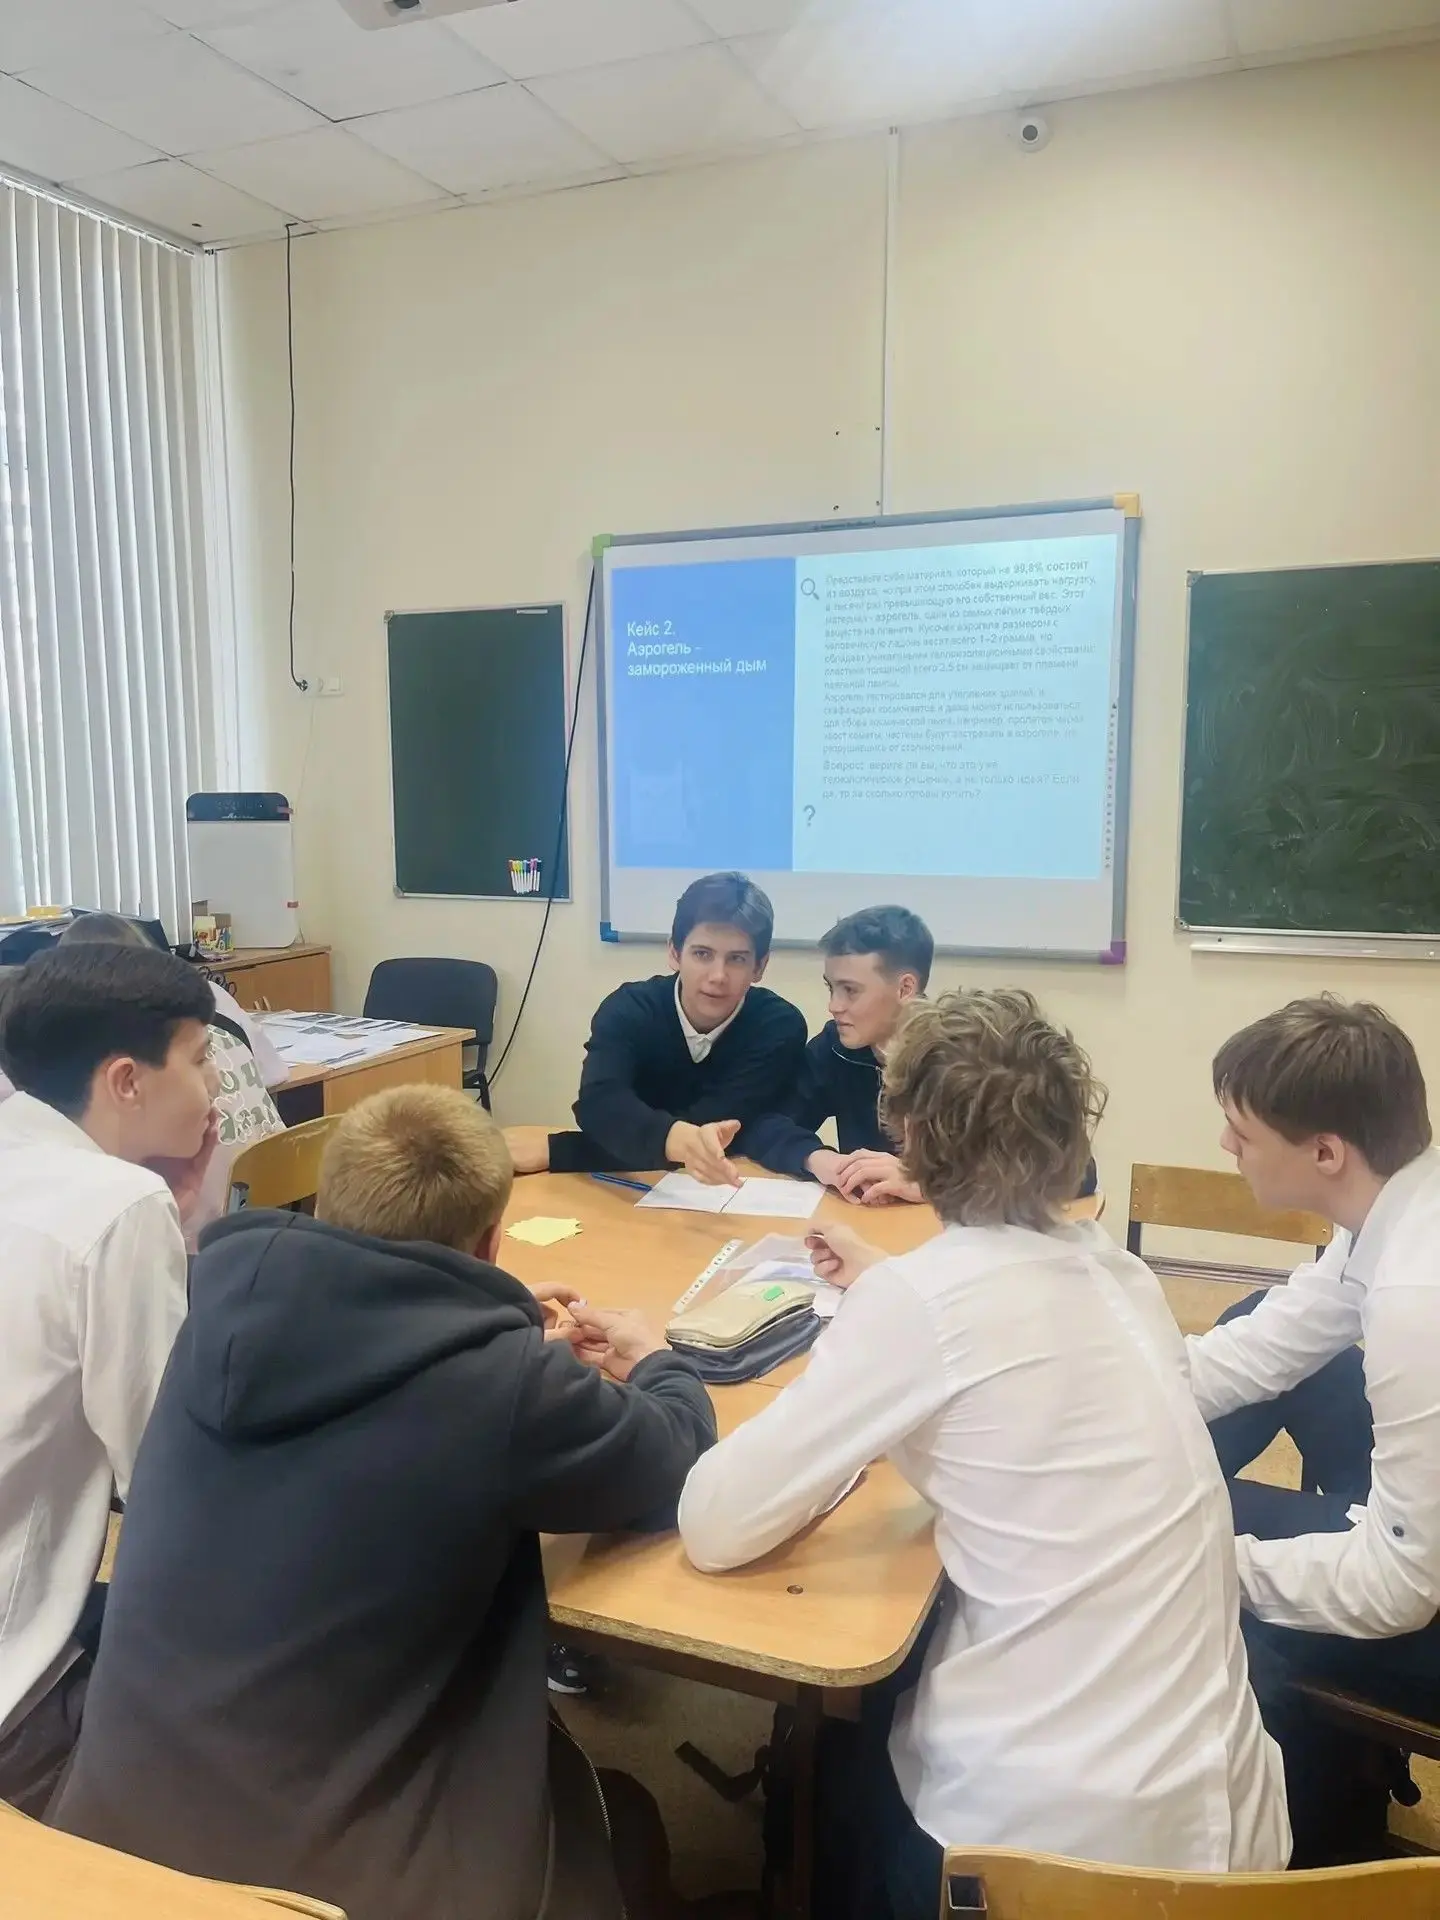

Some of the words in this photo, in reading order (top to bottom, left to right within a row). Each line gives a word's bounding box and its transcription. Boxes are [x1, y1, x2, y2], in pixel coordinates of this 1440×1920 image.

[627, 620, 660, 638] Кейс
[664, 619, 676, 636] 2.
[627, 641, 692, 658] Аэрогель
[627, 658, 732, 678] замороженный
[735, 659, 767, 675] дым
